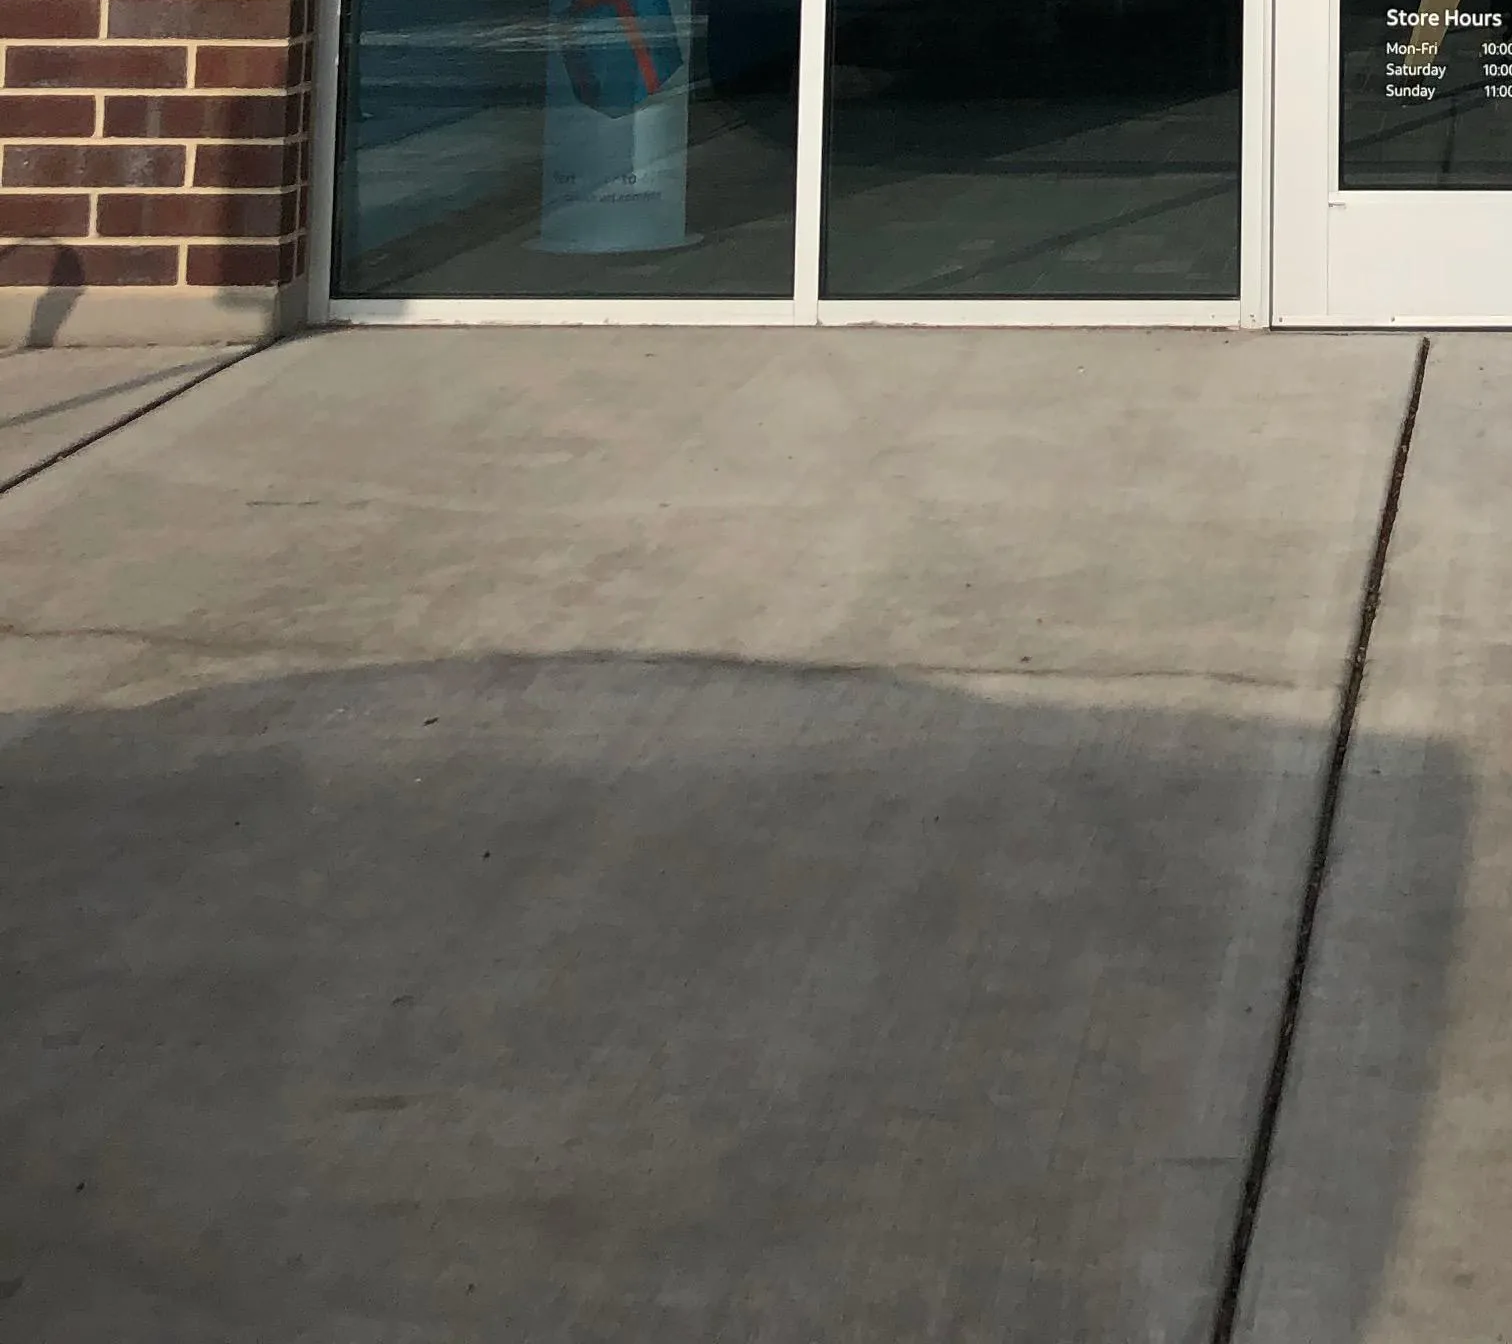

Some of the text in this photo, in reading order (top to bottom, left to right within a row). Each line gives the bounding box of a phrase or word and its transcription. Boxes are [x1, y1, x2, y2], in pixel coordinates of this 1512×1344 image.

[1386, 9, 1502, 27] Store Hours
[1386, 42, 1438, 55] Mon-Fri
[1386, 63, 1446, 78] Saturday
[1386, 84, 1436, 100] Sunday
